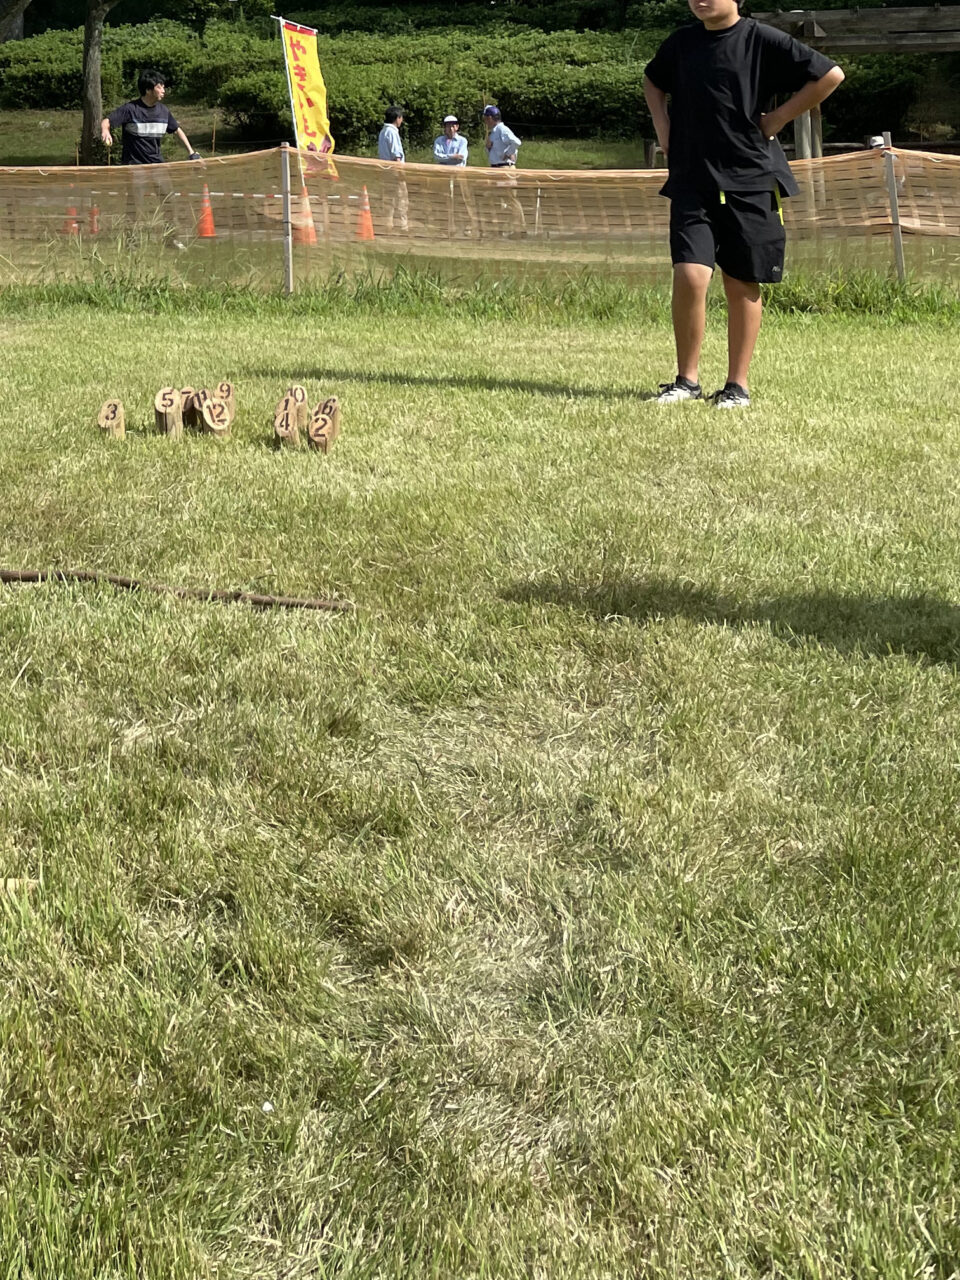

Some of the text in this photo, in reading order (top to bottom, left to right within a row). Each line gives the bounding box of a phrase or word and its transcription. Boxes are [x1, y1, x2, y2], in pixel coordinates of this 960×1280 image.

[161, 389, 174, 408] 5
[219, 383, 231, 399] 9
[181, 391, 193, 411] 7
[318, 398, 336, 416] 6
[105, 403, 118, 421] 3
[207, 403, 227, 423] 12
[279, 412, 290, 431] 4
[314, 417, 328, 437] 2
